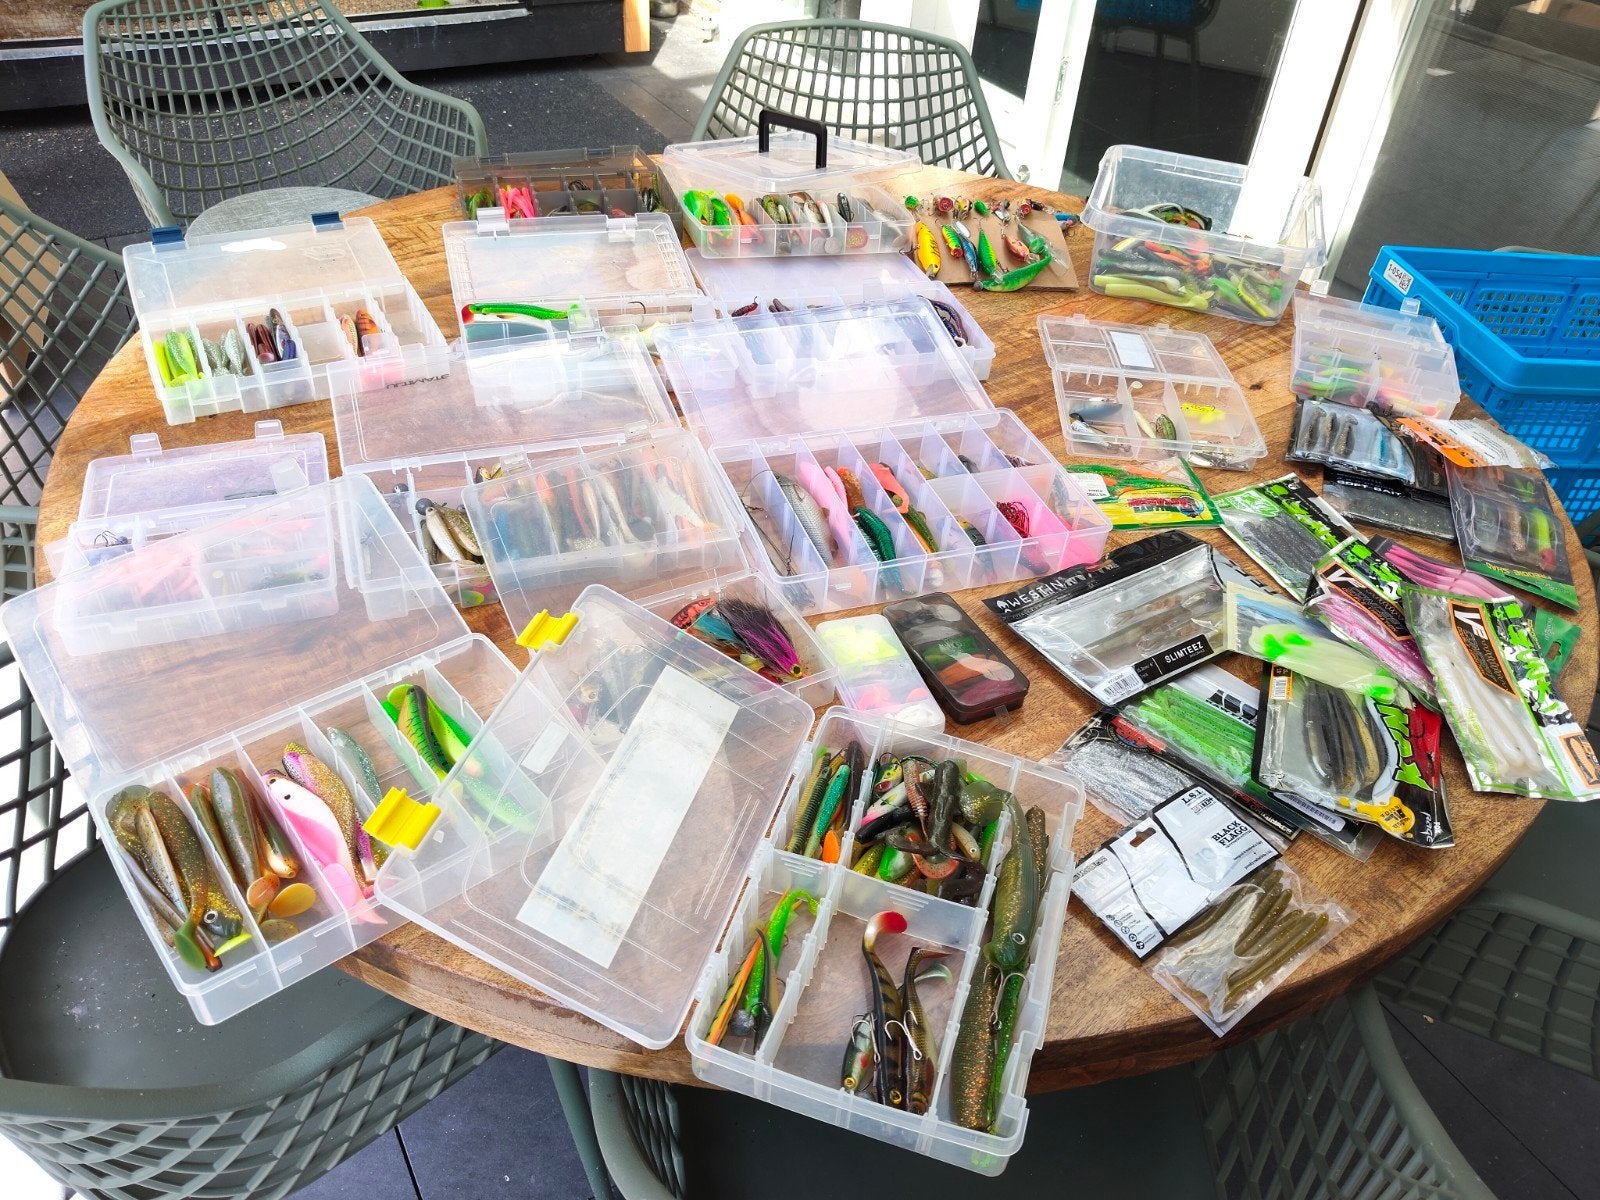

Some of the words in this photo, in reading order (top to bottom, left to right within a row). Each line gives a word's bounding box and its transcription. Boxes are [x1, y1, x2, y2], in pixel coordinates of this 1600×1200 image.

[1006, 577, 1065, 608] WESTIN
[1164, 641, 1204, 664] SLIMTEEZ
[1211, 820, 1241, 841] BLACK
[1218, 825, 1248, 846] FLAGG
